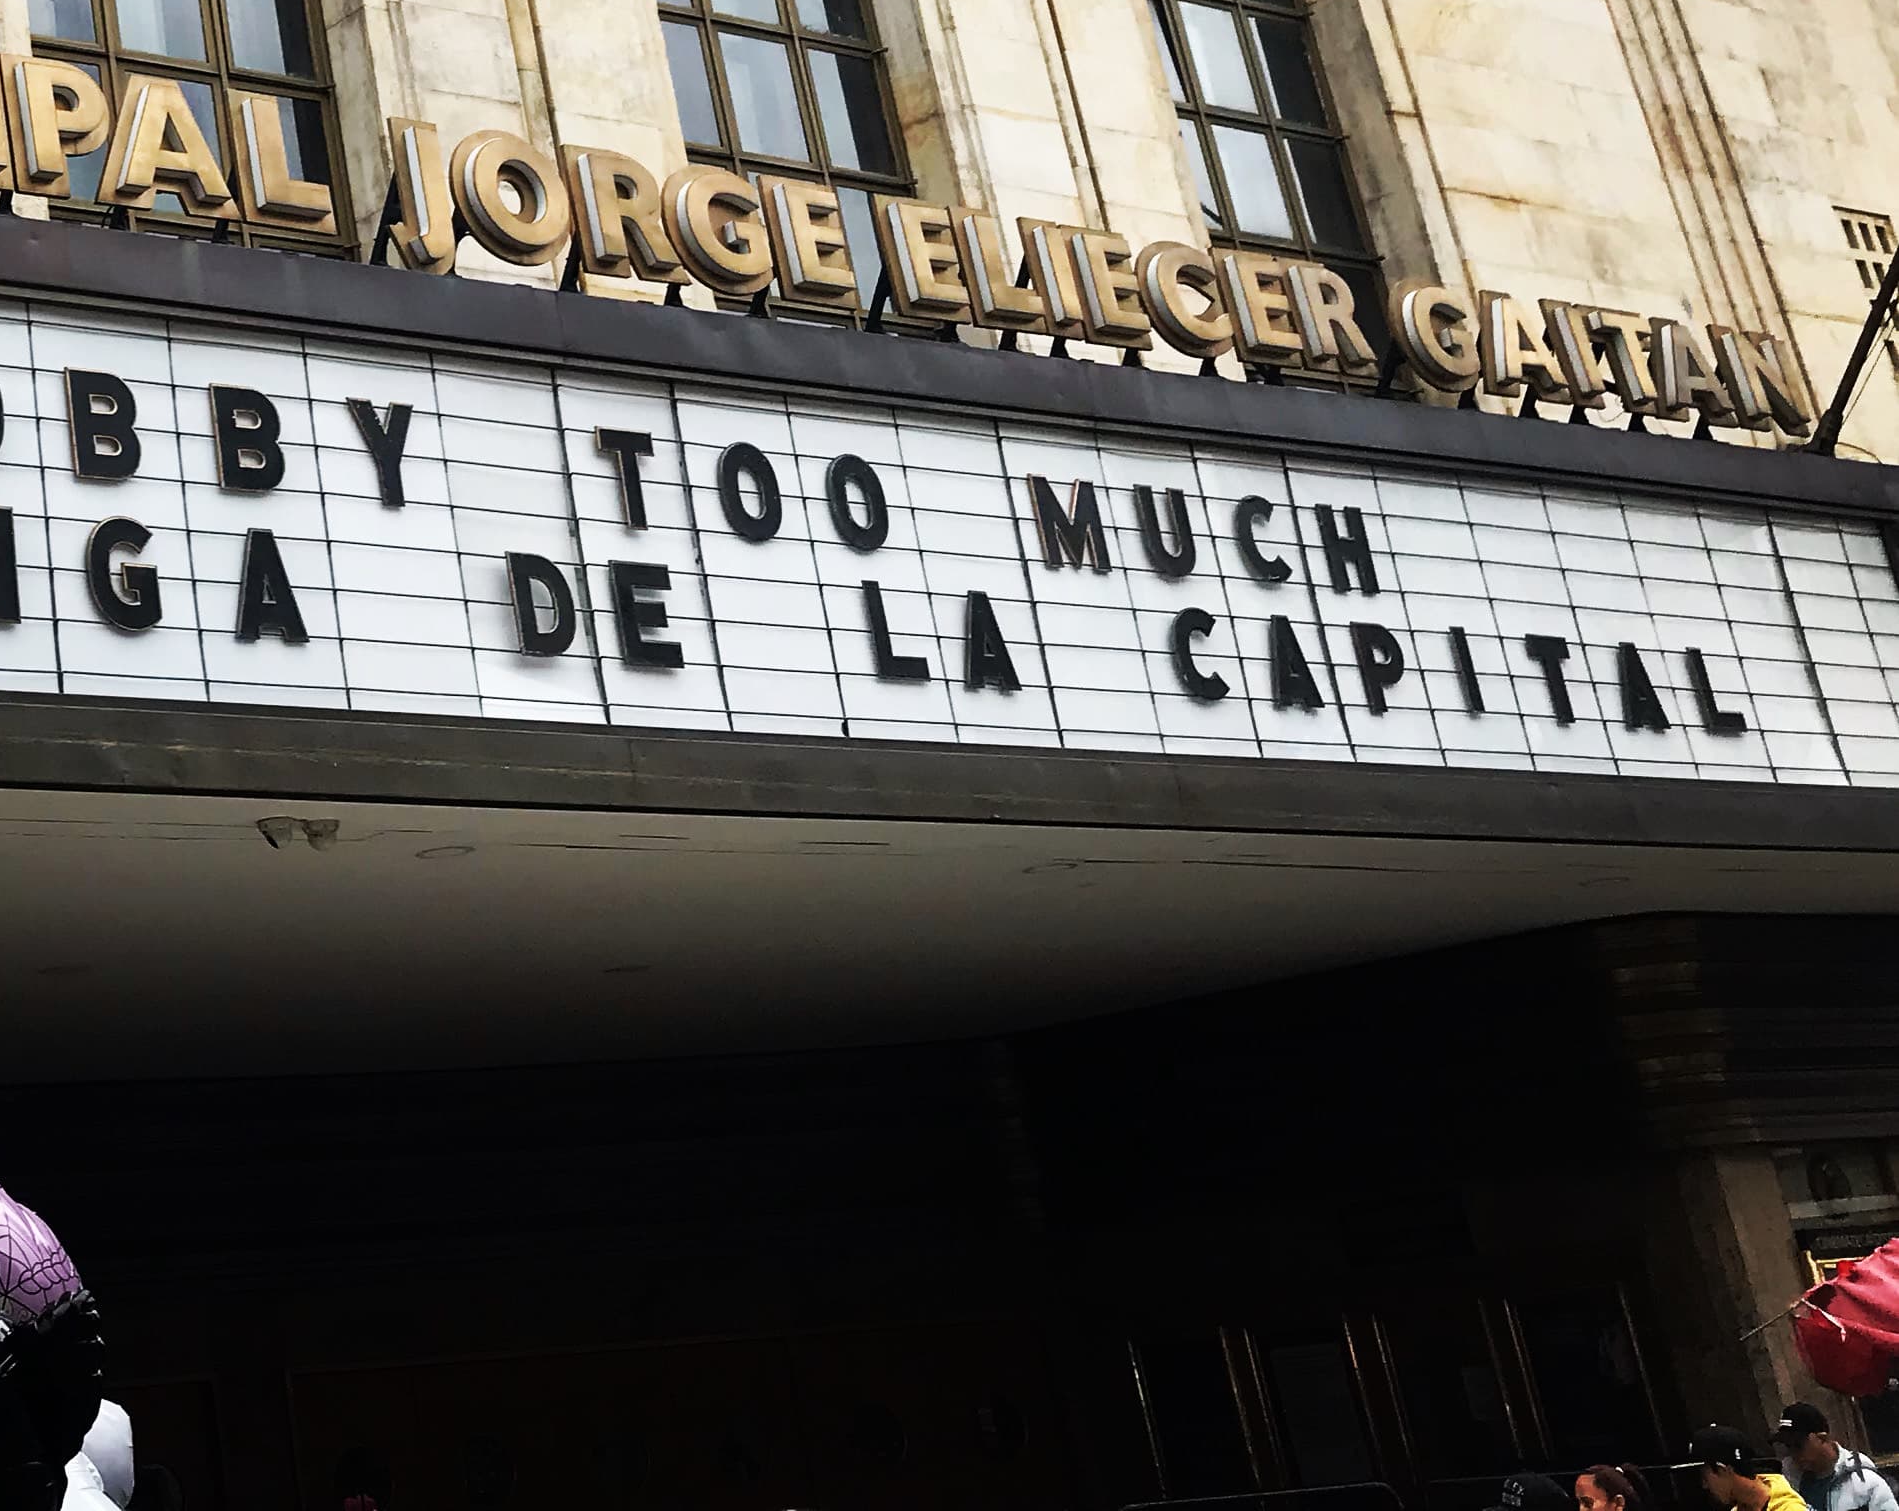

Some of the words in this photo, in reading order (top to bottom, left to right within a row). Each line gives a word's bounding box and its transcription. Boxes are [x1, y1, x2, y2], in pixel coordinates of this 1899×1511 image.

[386, 117, 859, 308] JORGE
[875, 194, 1379, 378] ELIECER
[1389, 280, 1810, 437] GAITAN
[596, 426, 890, 552] TOO
[1026, 473, 1380, 595] MUCH
[505, 552, 685, 669] DE
[861, 580, 1022, 692] LA
[1171, 608, 1747, 736] CAPITAL
